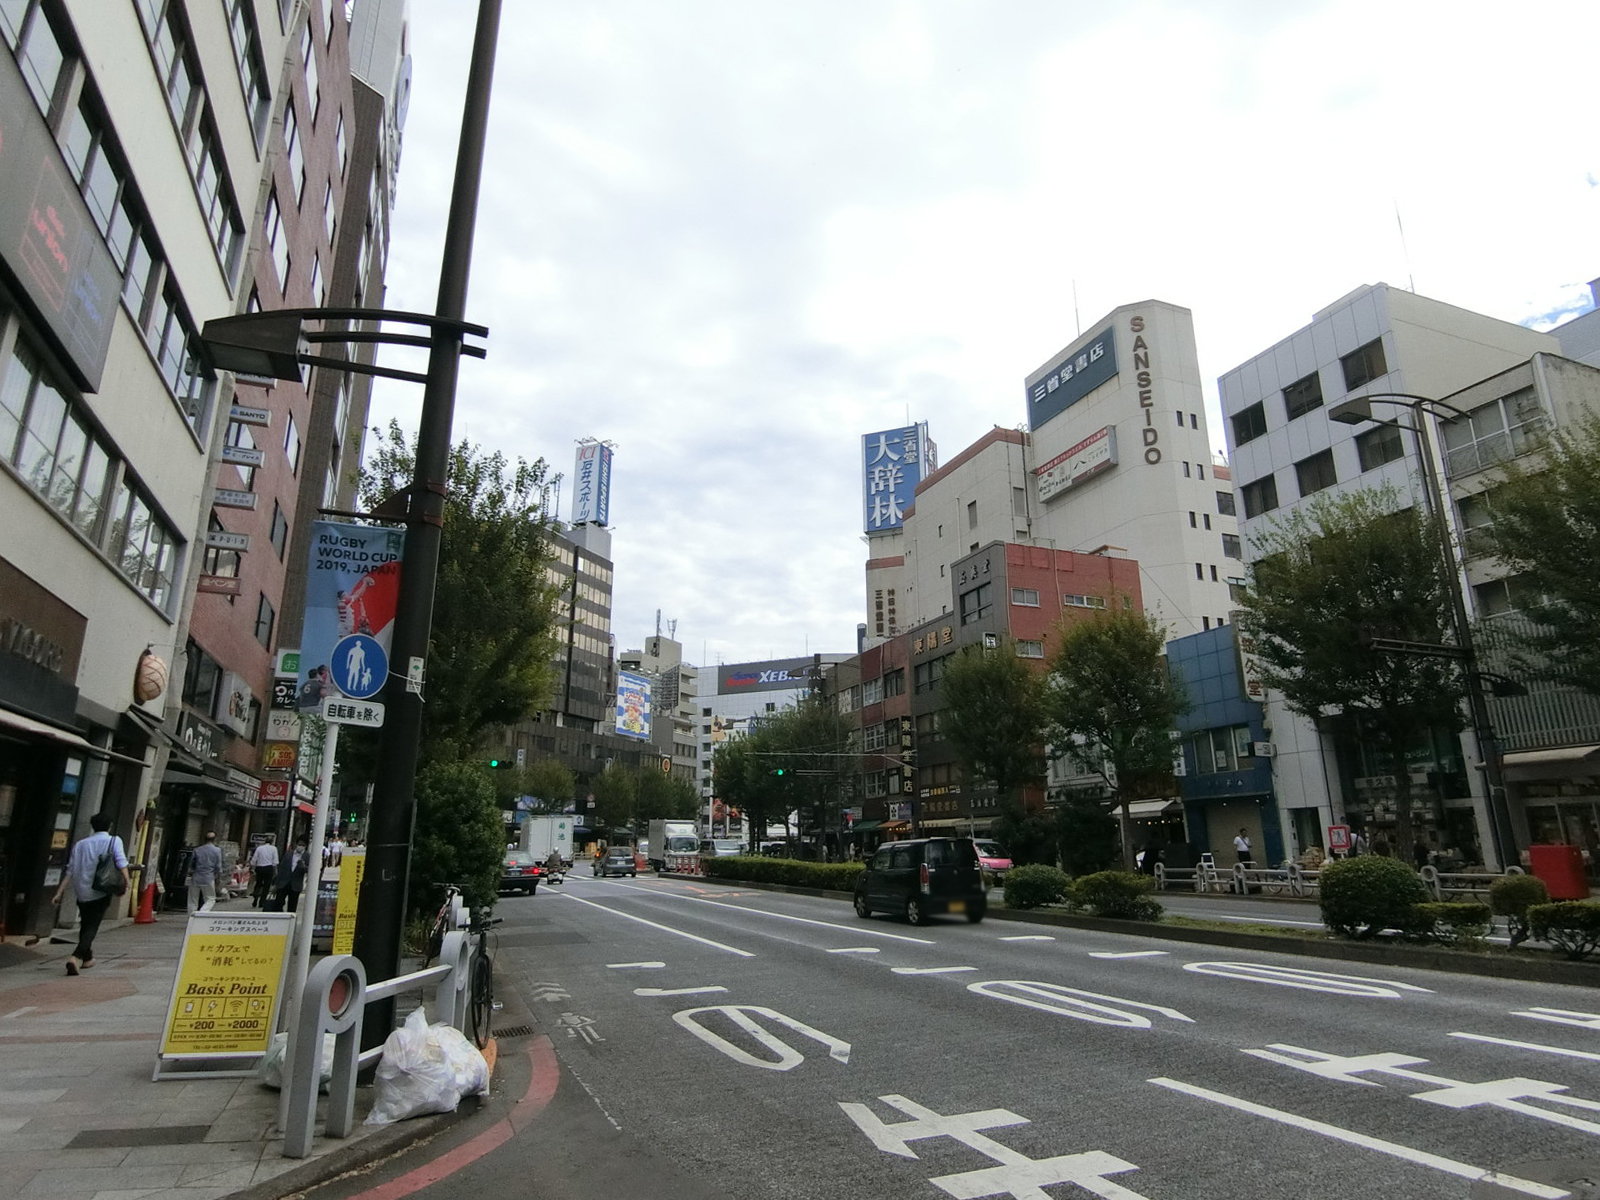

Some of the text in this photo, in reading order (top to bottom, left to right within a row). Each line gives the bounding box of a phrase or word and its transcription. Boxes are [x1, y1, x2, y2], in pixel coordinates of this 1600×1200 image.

[1034, 342, 1104, 403] 三省堂書店
[1130, 315, 1162, 465] SANSEIDO
[579, 446, 597, 461] ICI
[902, 428, 918, 465] 三省堂
[868, 433, 904, 528] 大辞林
[576, 460, 593, 523] 石井スポーツ
[319, 534, 368, 549] RUGBY
[318, 547, 398, 563] WORLD CUP
[316, 559, 397, 576] 2019, JAPAN
[913, 626, 953, 655] 東陽堂
[304, 683, 311, 694] 6
[327, 703, 380, 723] 自転車を除く
[901, 720, 913, 793] 東陽堂書店
[200, 944, 251, 953] まだカフェで
[185, 982, 268, 995] Basis Point
